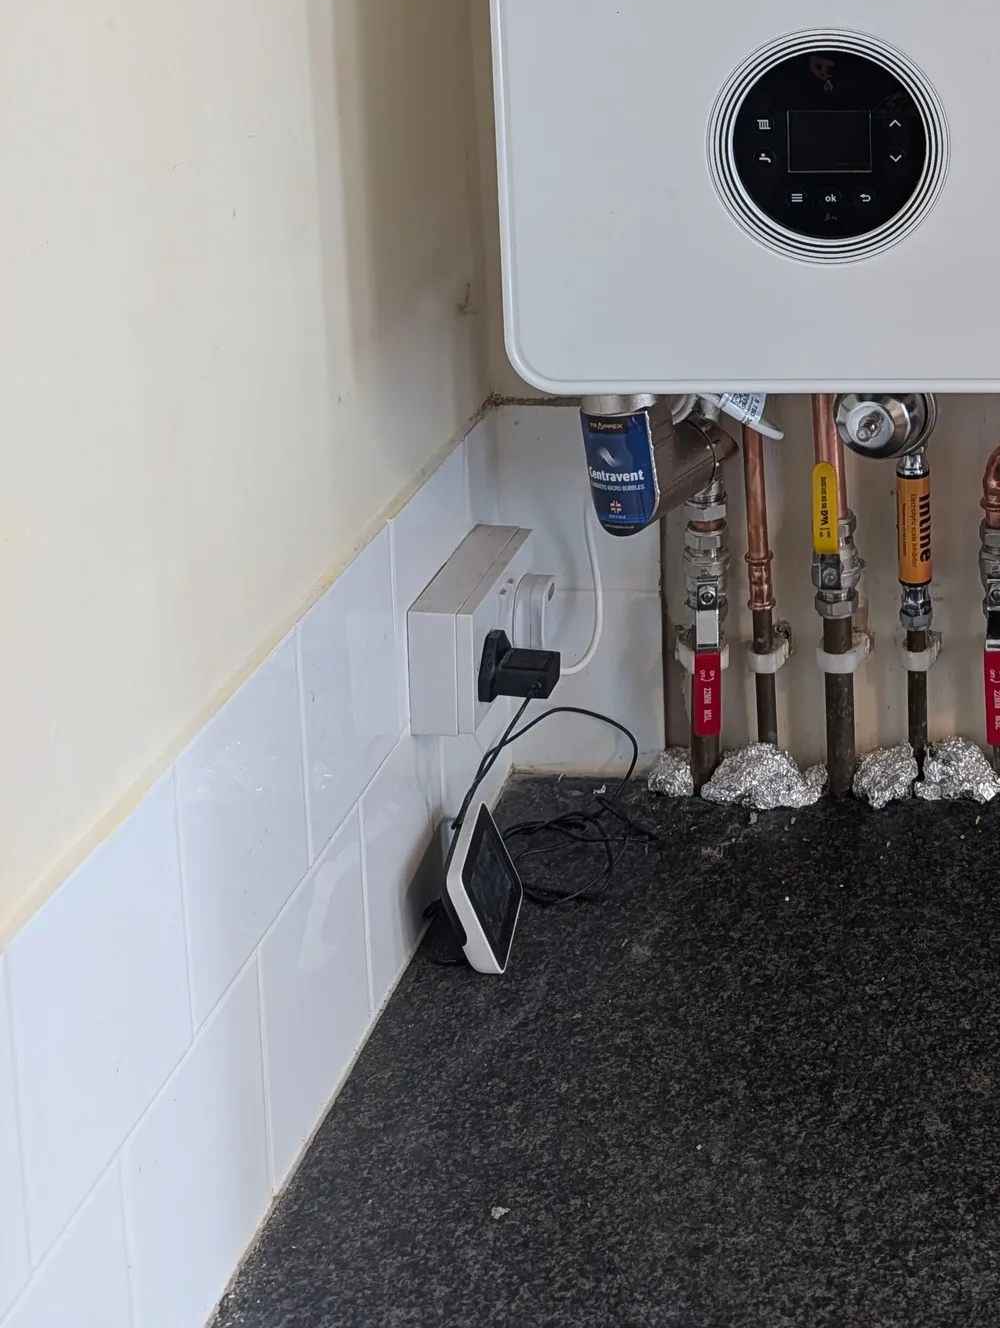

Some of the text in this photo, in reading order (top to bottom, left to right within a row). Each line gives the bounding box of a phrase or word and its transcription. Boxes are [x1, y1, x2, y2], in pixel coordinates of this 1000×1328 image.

[825, 194, 837, 202] ok
[588, 465, 645, 482] Centravent
[622, 483, 645, 492] BUBBLES
[910, 493, 918, 526] Electrolytic
[911, 527, 919, 542] scale
[703, 687, 712, 704] 22MM
